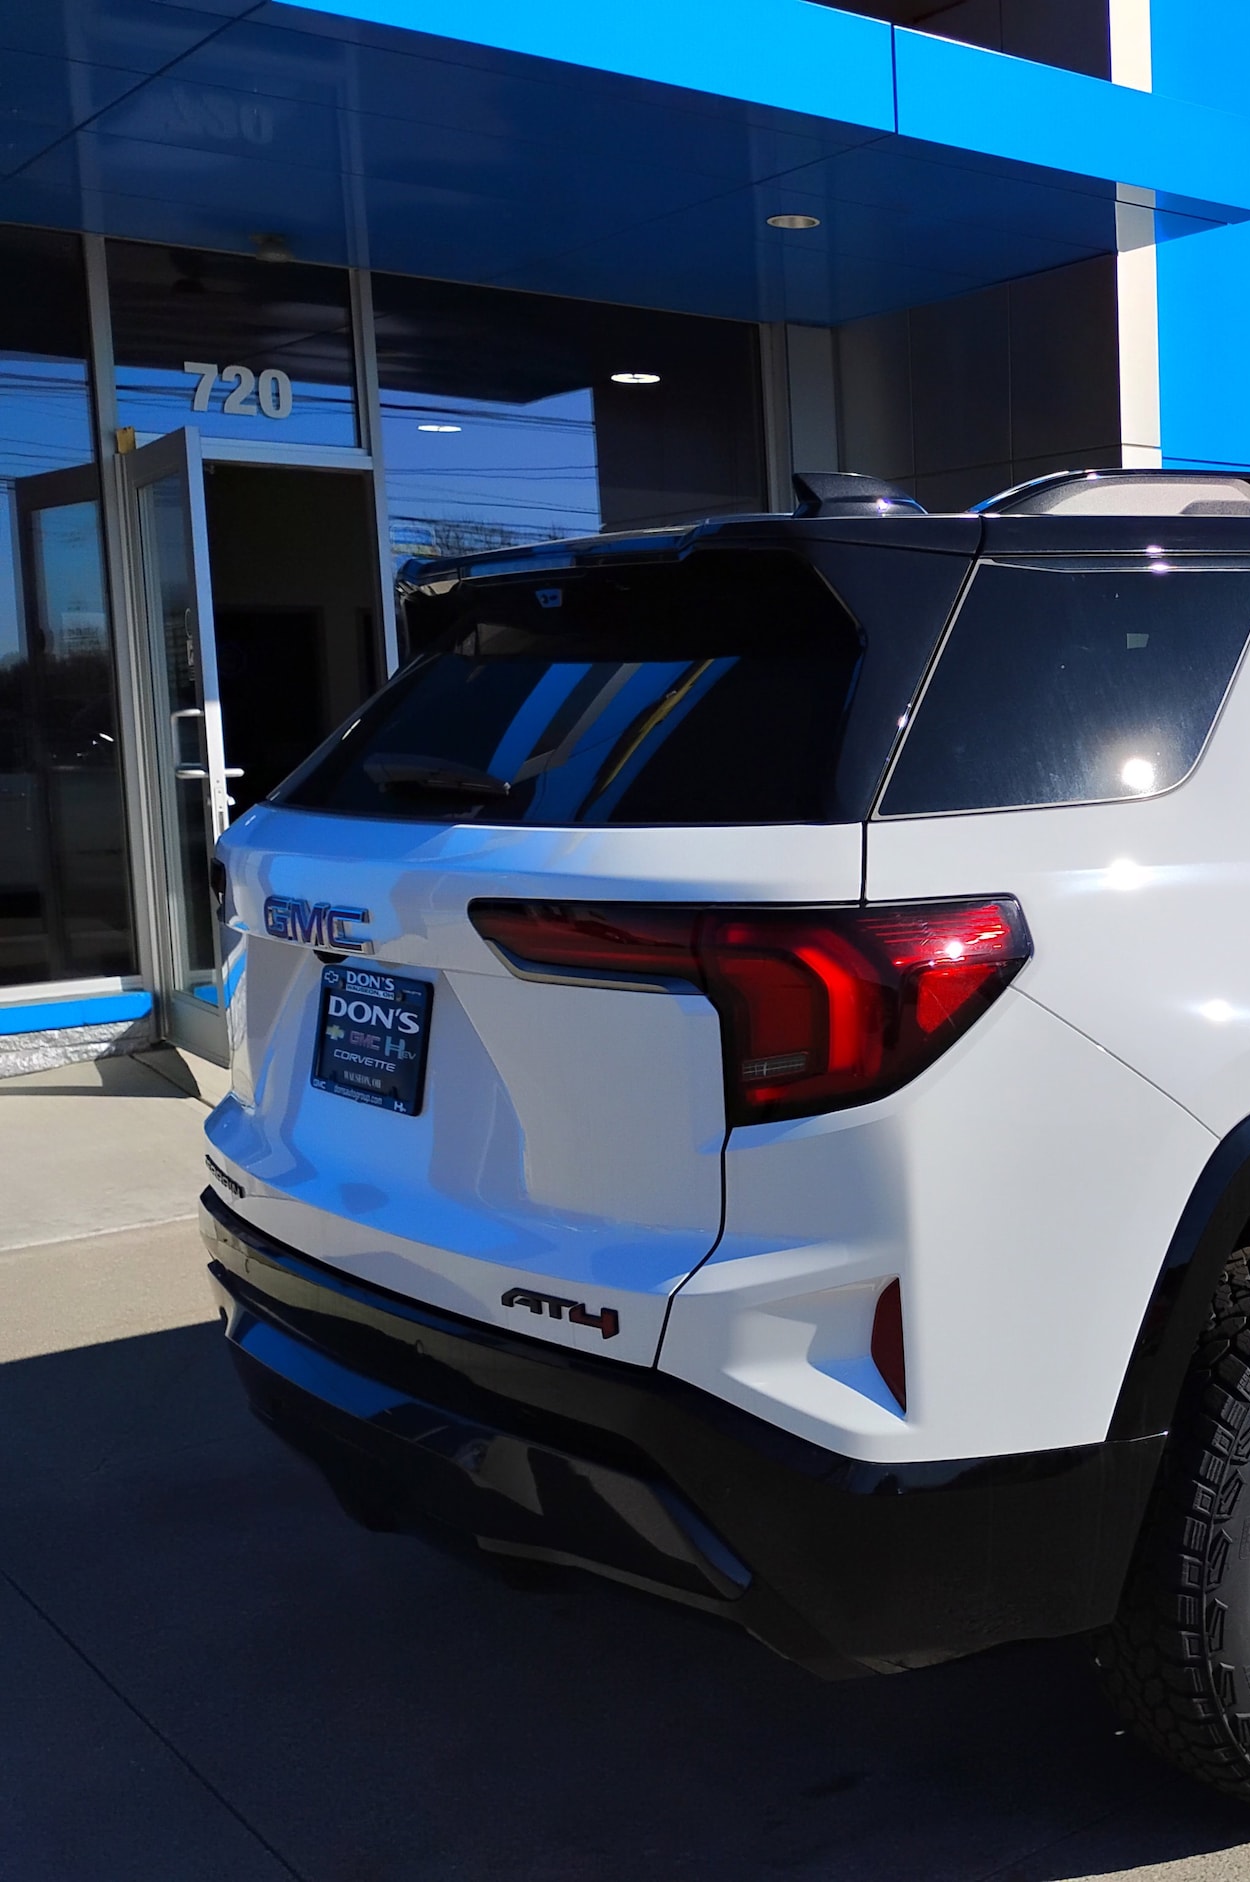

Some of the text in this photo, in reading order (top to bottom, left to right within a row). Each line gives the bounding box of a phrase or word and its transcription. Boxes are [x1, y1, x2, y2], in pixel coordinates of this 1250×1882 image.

[183, 361, 293, 419] 720
[264, 895, 375, 955] GMC
[345, 970, 395, 991] DON'S
[328, 995, 420, 1034] DON'S
[333, 1048, 396, 1073] CORVETTE
[350, 1031, 381, 1051] GMC
[501, 1287, 620, 1340] AT4
